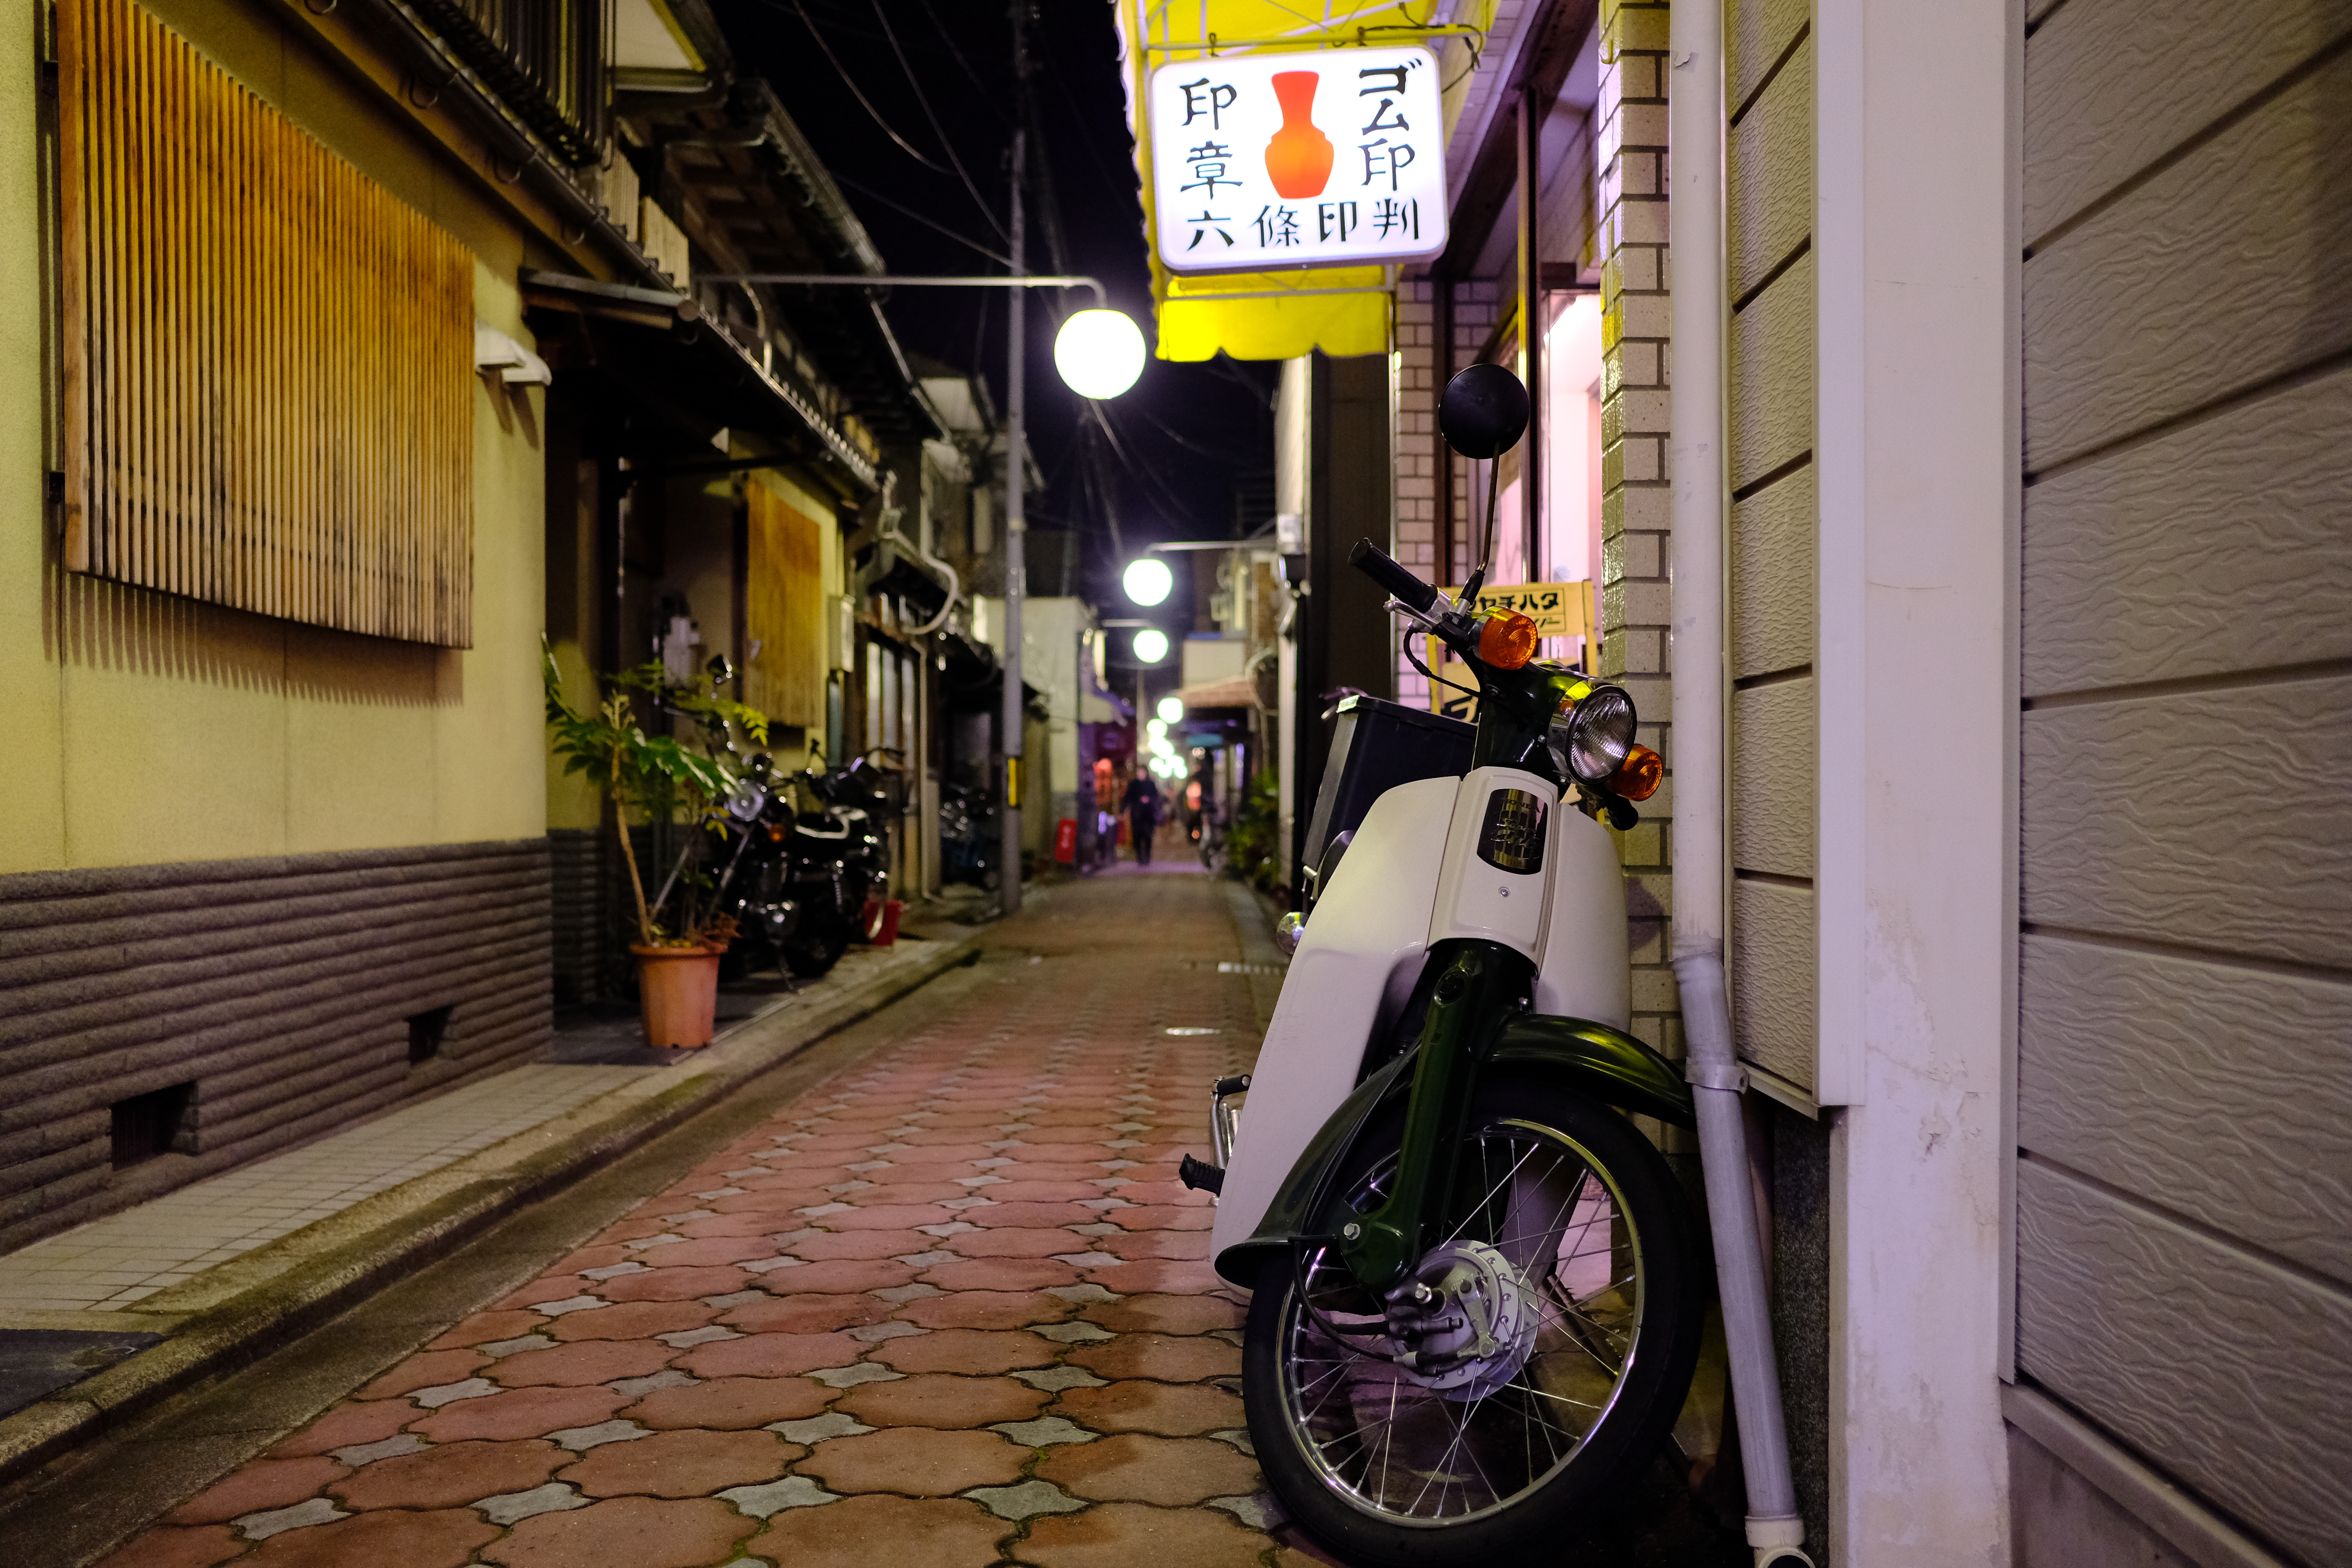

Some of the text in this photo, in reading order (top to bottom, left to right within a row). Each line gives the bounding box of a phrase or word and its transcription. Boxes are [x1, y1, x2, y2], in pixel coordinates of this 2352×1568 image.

[1180, 78, 1243, 200] 印章
[1358, 58, 1422, 191] ゴム印
[1186, 198, 1420, 252] 六條印判
